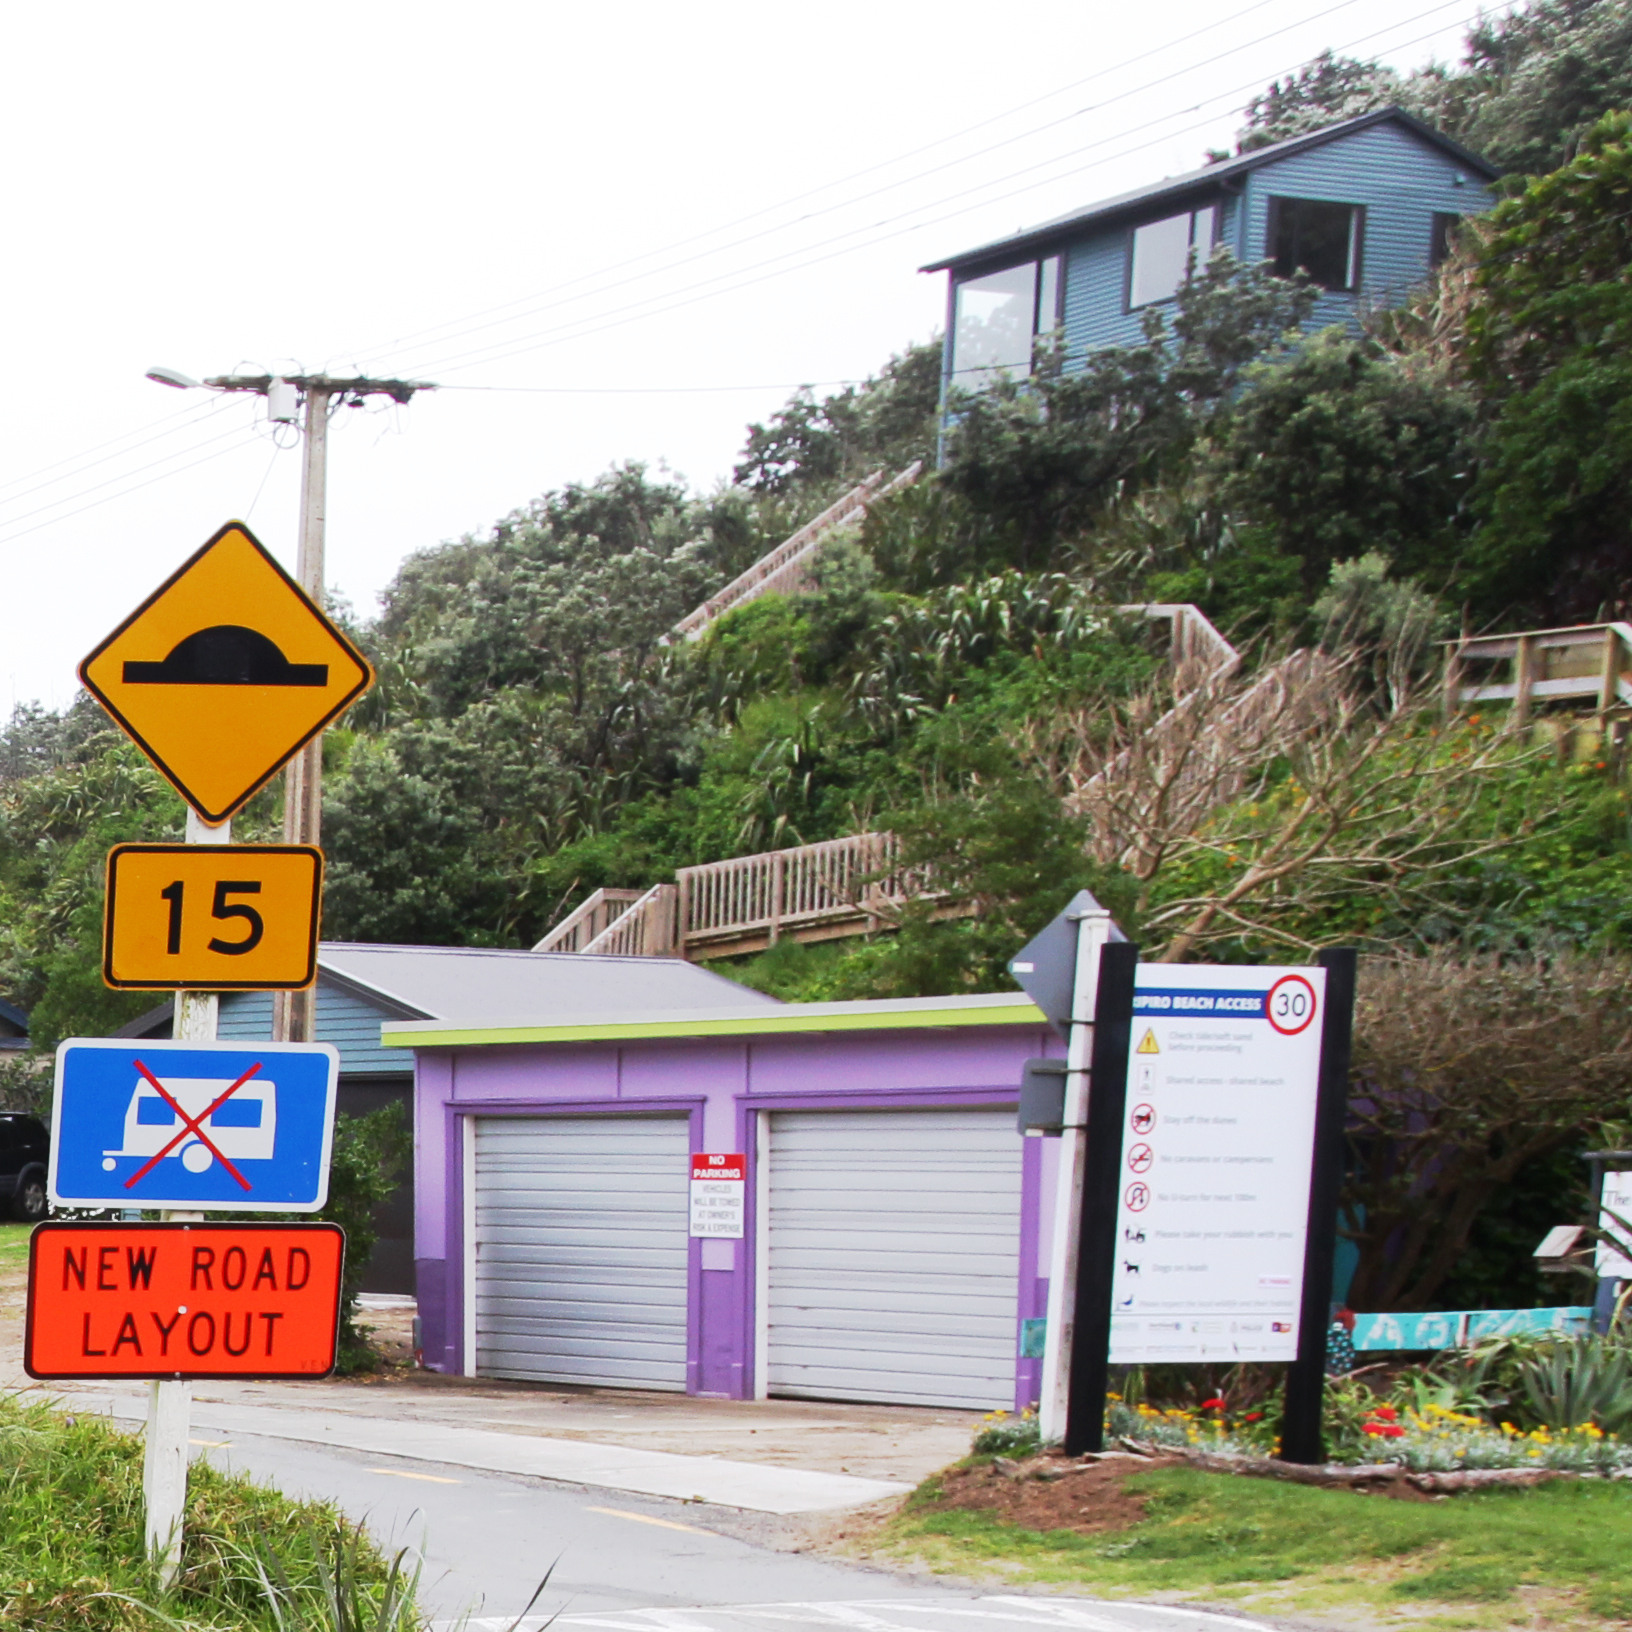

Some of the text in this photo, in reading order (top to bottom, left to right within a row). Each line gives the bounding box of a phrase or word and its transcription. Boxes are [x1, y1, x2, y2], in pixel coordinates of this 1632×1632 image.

[161, 881, 263, 956] 15
[1173, 996, 1213, 1009] BEACH
[1215, 997, 1262, 1011] ACCESS
[1277, 993, 1306, 1017] 30
[709, 1156, 725, 1165] NO
[694, 1169, 740, 1178] PARKING
[62, 1247, 311, 1291] NEW ROAD
[81, 1312, 284, 1357] LAYOUT
